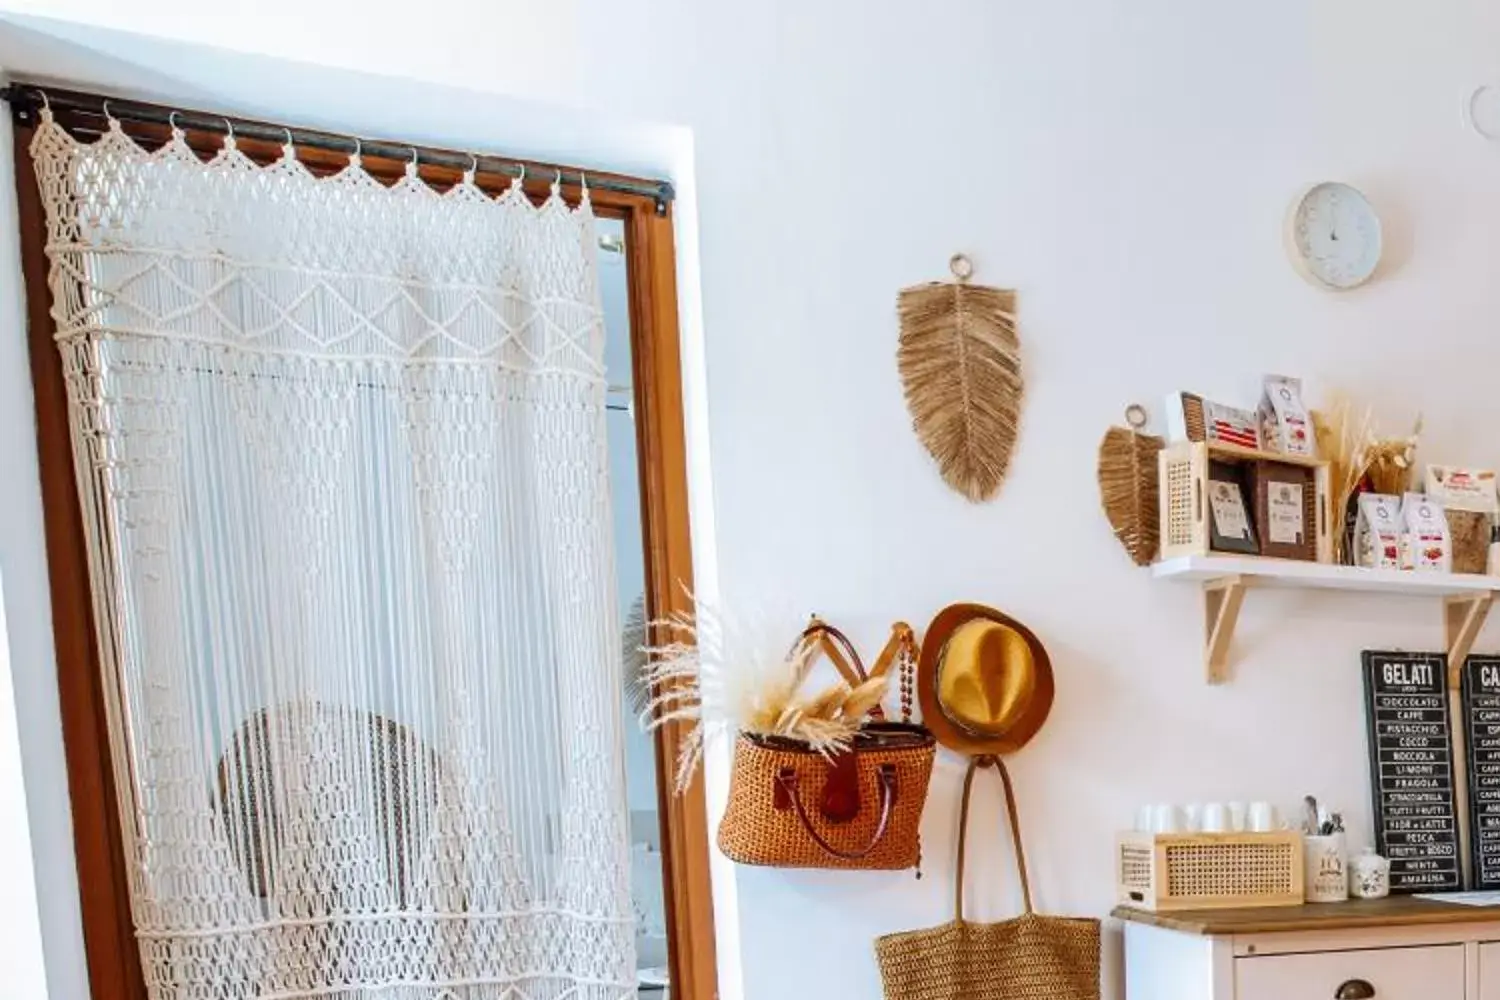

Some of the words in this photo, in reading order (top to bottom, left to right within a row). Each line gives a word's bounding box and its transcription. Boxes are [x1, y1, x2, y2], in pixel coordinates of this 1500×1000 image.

[1383, 663, 1433, 686] GELATI
[1382, 698, 1439, 707] CIOCCOLATO
[1387, 725, 1439, 735] PISTACCHIO
[1400, 737, 1429, 747] COCCO
[1393, 752, 1436, 761] NOCCIOLA
[1395, 779, 1439, 788] FRAGOLA
[1389, 807, 1413, 815] TUTTI
[1416, 806, 1445, 815] FRUTTI
[1421, 819, 1446, 829] LATTE
[1406, 833, 1435, 842] PESCA
